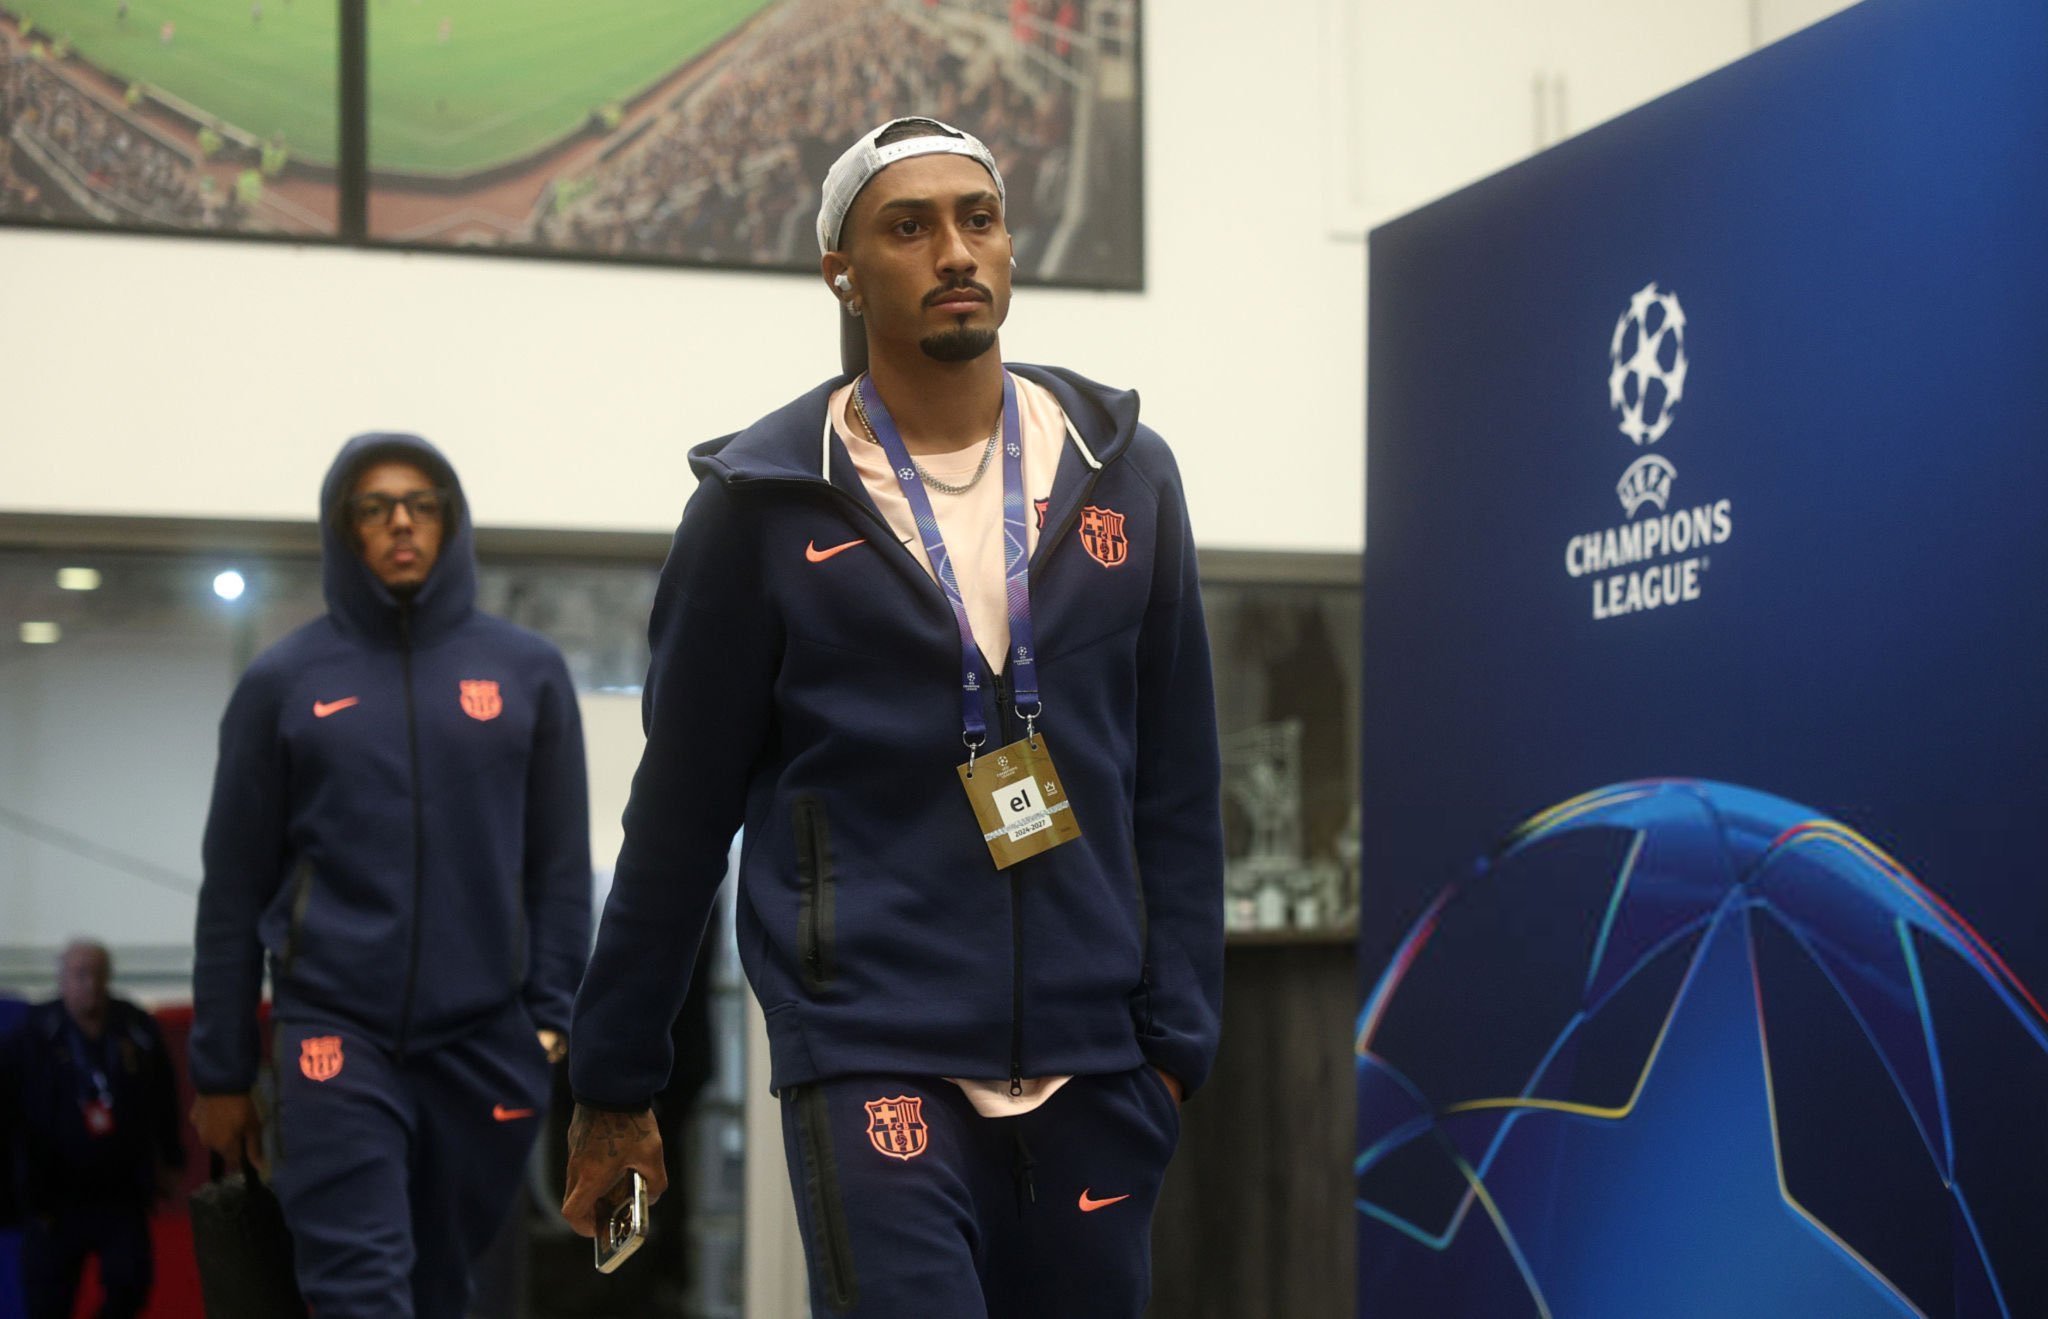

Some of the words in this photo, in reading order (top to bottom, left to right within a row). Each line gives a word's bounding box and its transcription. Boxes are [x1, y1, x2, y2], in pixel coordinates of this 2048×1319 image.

[1565, 499, 1732, 577] CHAMPIONS
[1593, 558, 1700, 620] LEAGUE
[1010, 789, 1031, 812] el
[1015, 820, 1046, 838] 2024-2027
